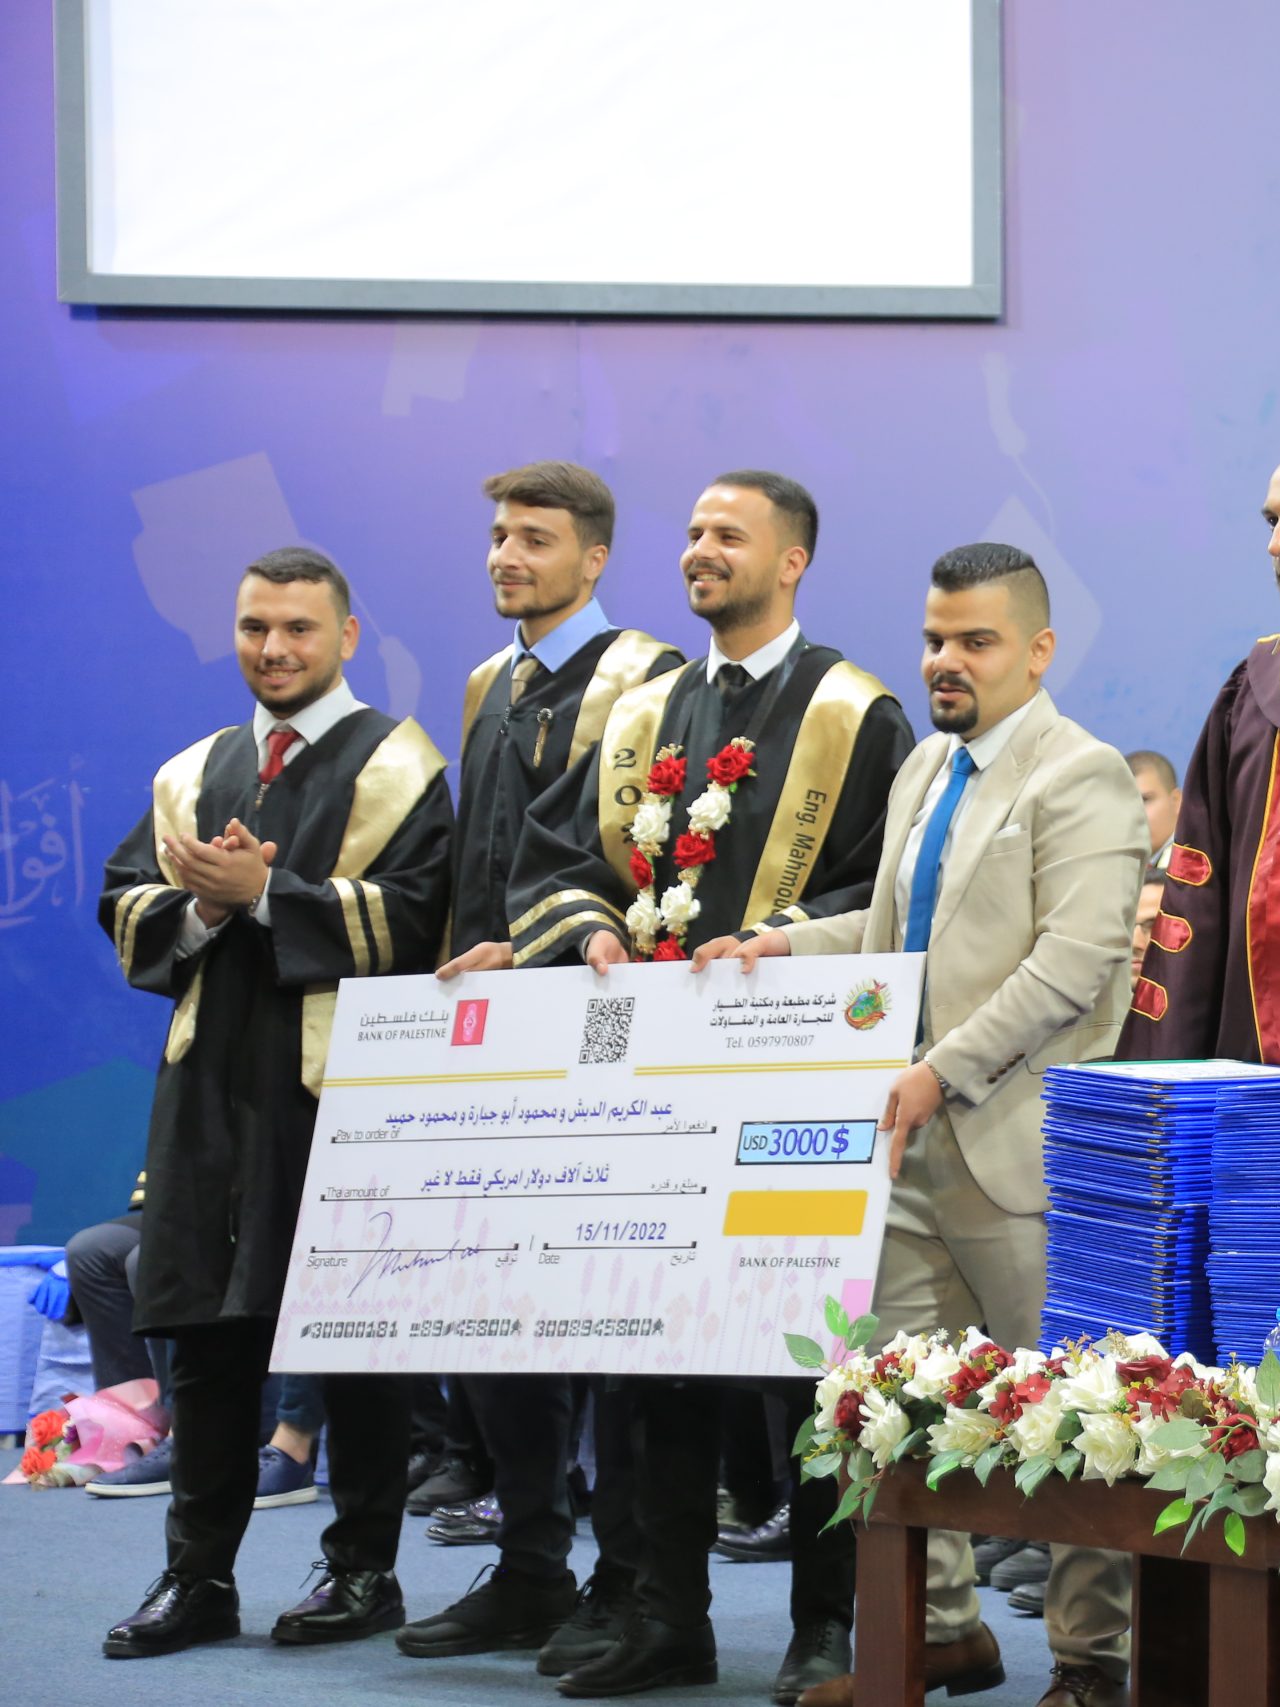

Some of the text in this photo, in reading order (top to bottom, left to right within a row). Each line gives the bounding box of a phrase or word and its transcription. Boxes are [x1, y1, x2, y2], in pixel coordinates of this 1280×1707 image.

[771, 789, 827, 916] Eng. Mahmou
[712, 998, 748, 1013] الطيار
[781, 995, 811, 1010] مطبعة
[811, 992, 837, 1008] شركة
[360, 1010, 449, 1027] بنك فلسطين
[766, 1014, 792, 1026] العامة
[793, 1012, 835, 1027] للتجارة
[358, 1028, 447, 1041] BANK OF PALESTINE
[725, 1034, 815, 1049] Tel. 0597970807
[468, 1104, 498, 1126] جبارة
[500, 1096, 518, 1126] أبو
[518, 1106, 557, 1125] محمود
[567, 1098, 606, 1123] الدبش
[607, 1099, 648, 1122] الكريم
[649, 1102, 673, 1120] عبد
[385, 1112, 415, 1129] حميد
[419, 1110, 458, 1128] محمود
[336, 1127, 401, 1141] Pay to order of
[743, 1135, 768, 1151] USD
[420, 1170, 441, 1192] غير
[443, 1170, 454, 1186] لا
[455, 1168, 482, 1186] فقط
[524, 1167, 551, 1189] دولار
[582, 1163, 610, 1184] ثلاث
[344, 1187, 378, 1198] amount
[380, 1185, 391, 1197] of
[679, 1178, 698, 1194] مبلغ
[575, 1221, 667, 1242] 15/11/2022
[306, 1256, 348, 1268] Signature
[495, 1252, 518, 1268] توقيع
[538, 1252, 560, 1265] Date
[669, 1251, 697, 1266] تاريخ
[738, 1256, 841, 1269] BANK OF PALESTINE
